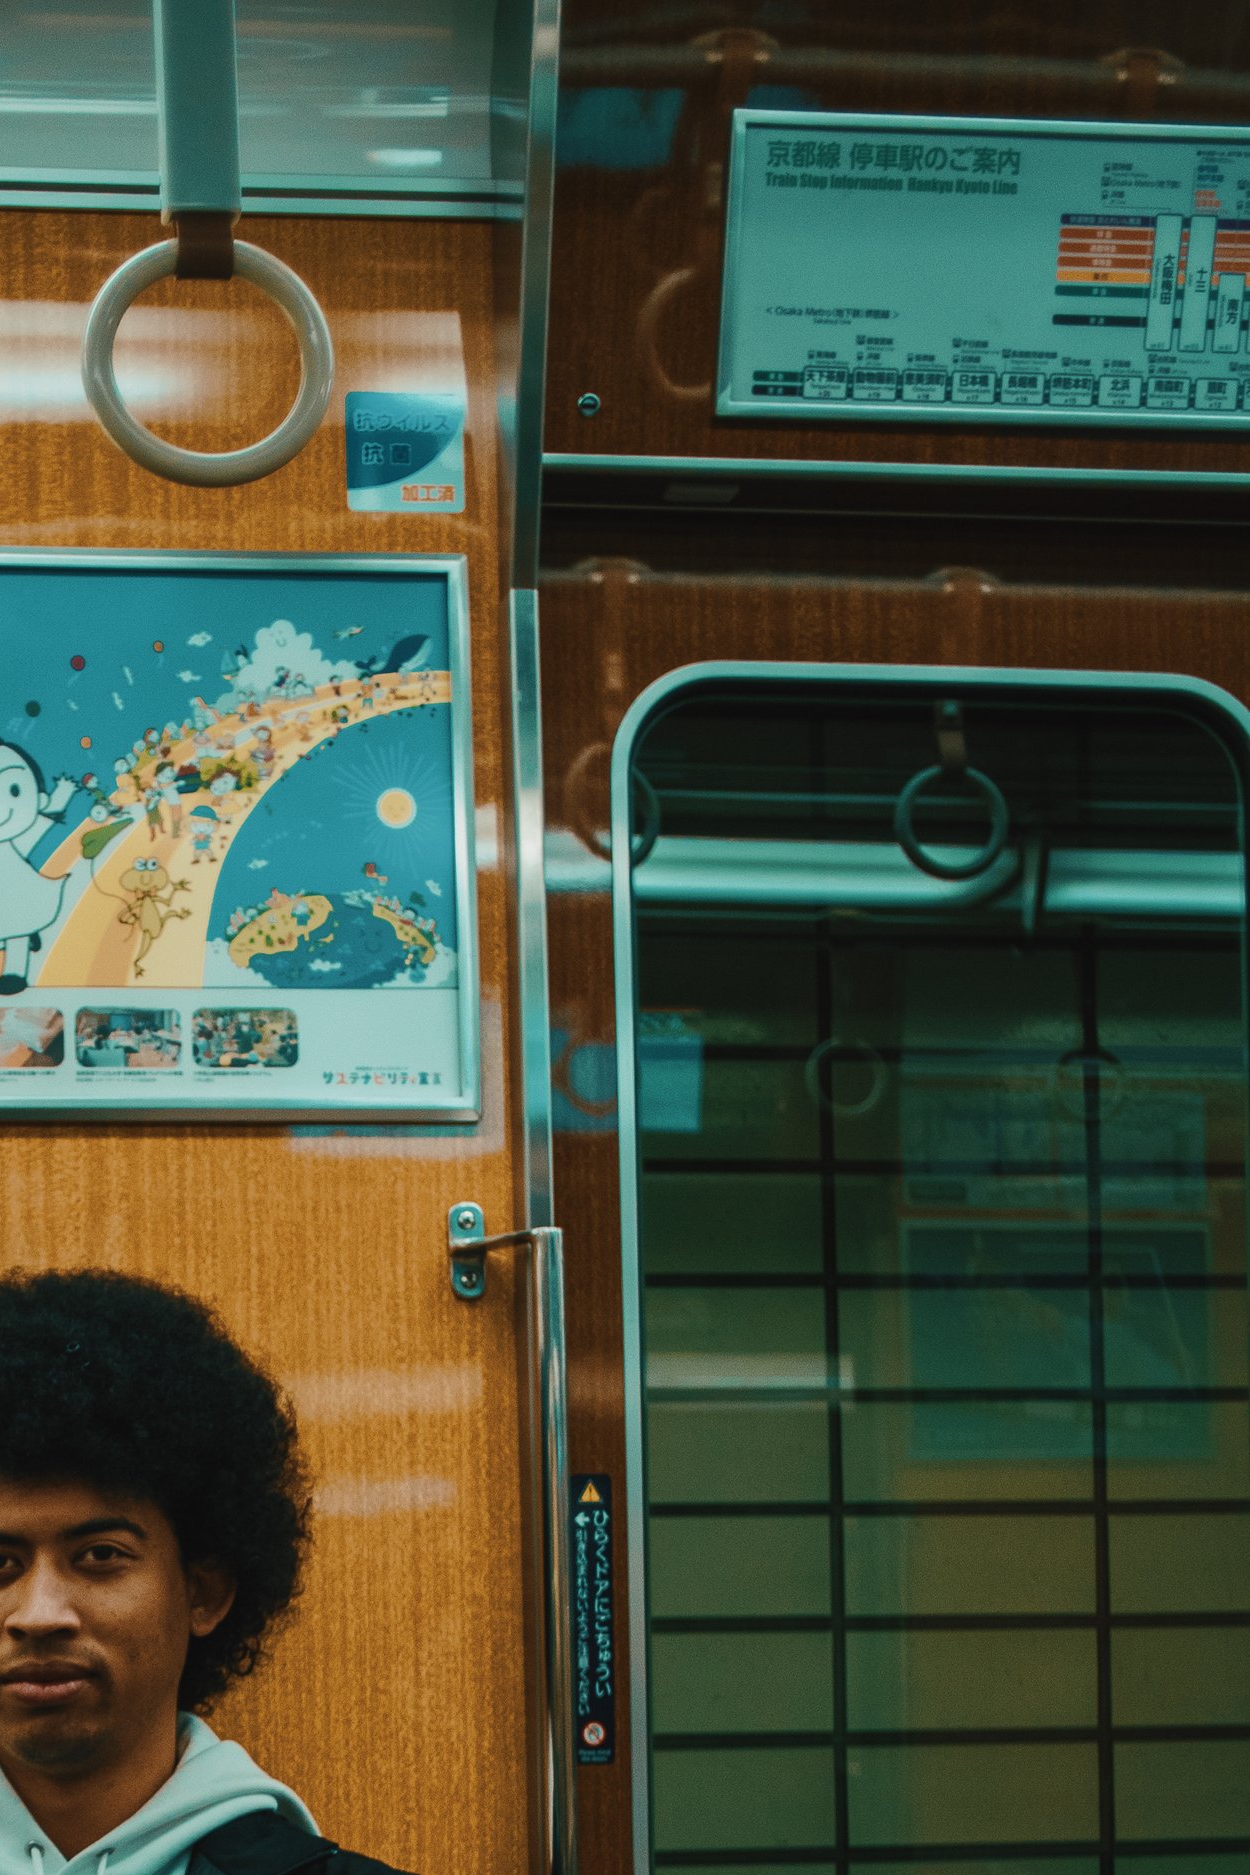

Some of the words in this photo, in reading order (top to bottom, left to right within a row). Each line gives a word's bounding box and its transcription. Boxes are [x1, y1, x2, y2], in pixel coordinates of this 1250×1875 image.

[766, 140, 841, 168] 京都線
[849, 143, 1022, 175] 停車駅のご案内
[765, 172, 798, 187] Train
[800, 173, 827, 189] Stop
[830, 174, 903, 191] Information
[908, 177, 953, 194] Hankyu
[955, 178, 990, 195] Kyoto
[992, 179, 1018, 194] Line
[1195, 267, 1208, 293] 十三
